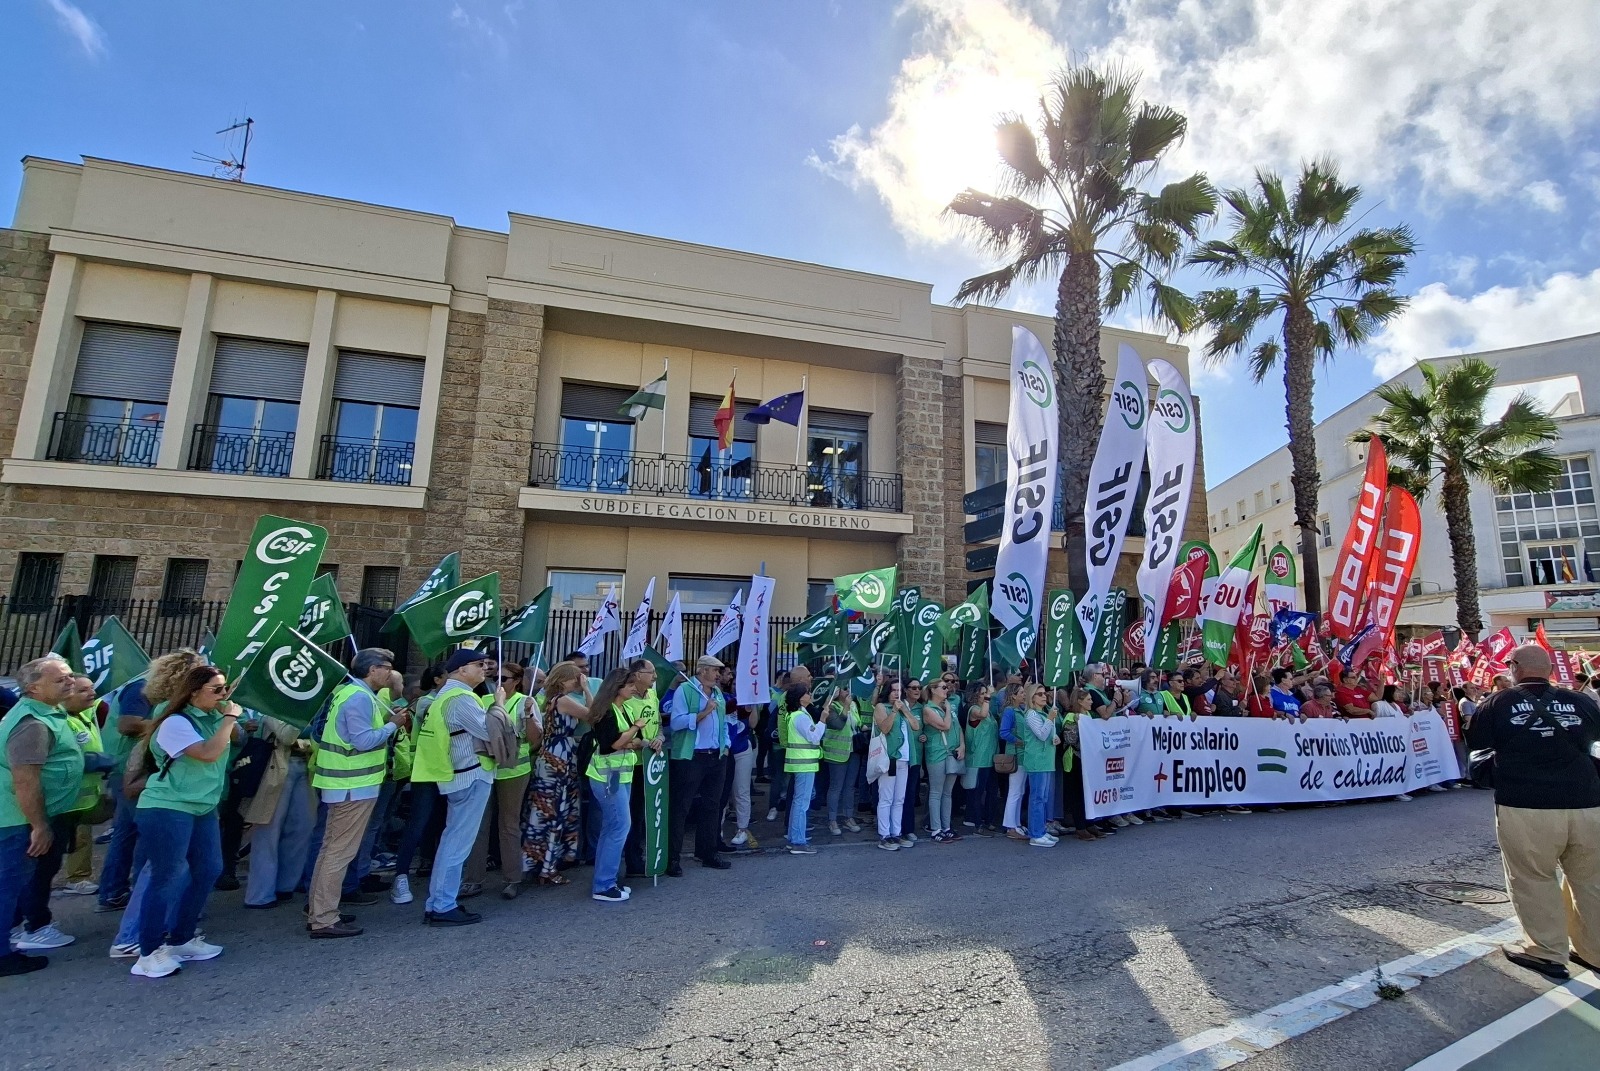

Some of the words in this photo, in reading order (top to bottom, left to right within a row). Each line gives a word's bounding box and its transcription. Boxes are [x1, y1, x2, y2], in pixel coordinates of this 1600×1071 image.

[581, 498, 737, 521] SUBDELEGACION
[747, 509, 778, 524] DEL
[789, 512, 871, 530] GOBIERNO
[455, 598, 494, 628] CSIF
[1252, 617, 1272, 633] UGT
[83, 643, 114, 674] SIF
[282, 645, 316, 688] CSIF
[920, 629, 934, 682] CSIF
[966, 626, 979, 677] CSIF
[1052, 623, 1064, 683] CSIF
[1553, 650, 1570, 681] CCOO
[1428, 659, 1440, 682] COO
[1444, 702, 1455, 735] CCOO
[1553, 703, 1576, 713] CLASS
[1152, 725, 1188, 755] Mejor
[1190, 727, 1239, 751] salario
[1294, 731, 1350, 757] Servicios
[1350, 731, 1406, 757] Públicos
[1172, 759, 1247, 799] Empleo
[1300, 760, 1325, 791] de
[1333, 755, 1408, 790] calidad
[1094, 788, 1112, 805] UGT
[654, 788, 663, 870] CSIF
